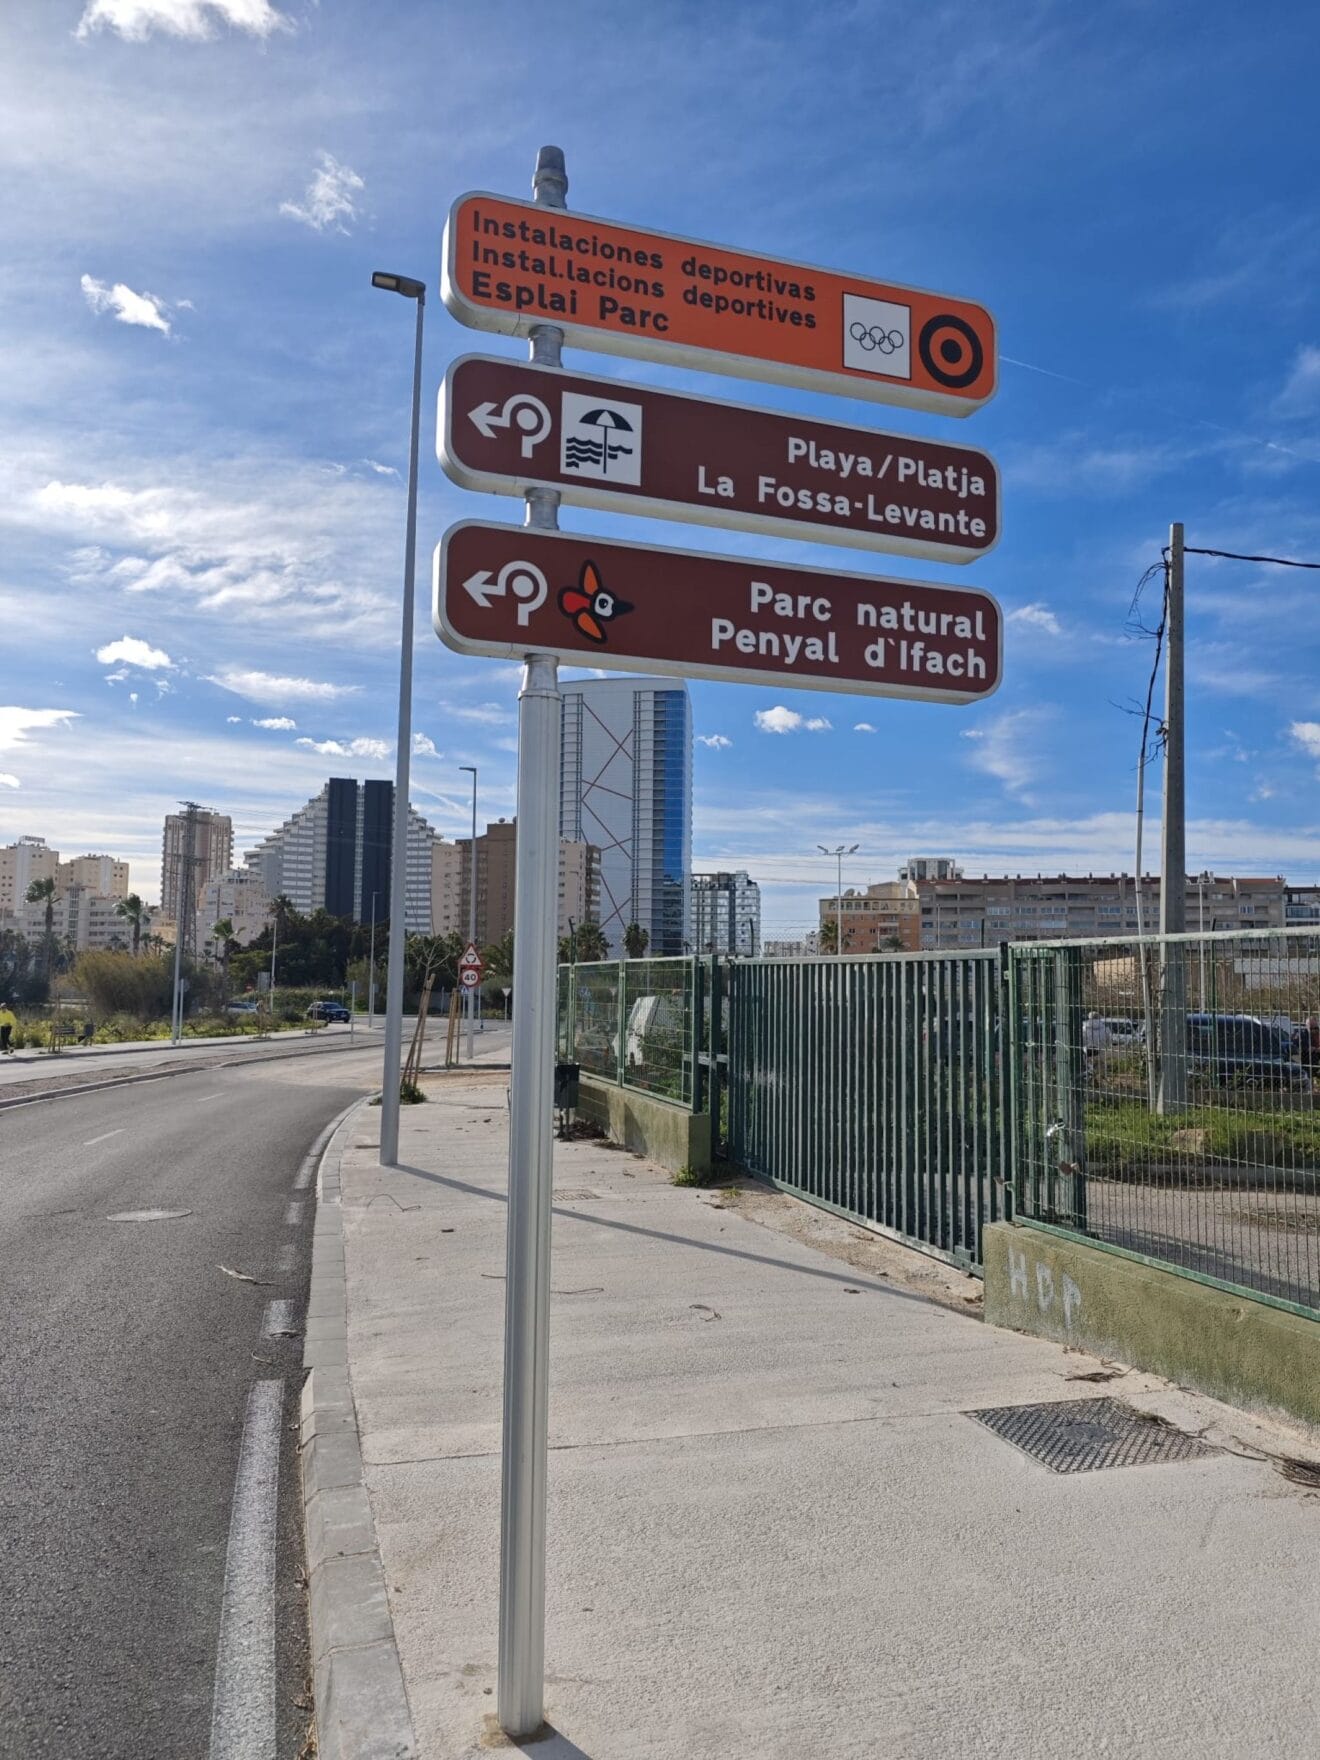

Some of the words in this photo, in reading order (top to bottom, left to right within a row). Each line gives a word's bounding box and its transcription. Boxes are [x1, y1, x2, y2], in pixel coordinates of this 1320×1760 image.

[473, 210, 663, 269] Instalaciones
[681, 256, 816, 301] deportivas
[472, 271, 577, 314] Esplai
[599, 296, 669, 332] Parc
[683, 285, 817, 329] deportives
[788, 437, 986, 498] Playa/Platja
[698, 466, 735, 498] La
[758, 476, 986, 538] Fossa-Levante
[711, 618, 839, 664] Penyal
[751, 581, 832, 621] Parc
[857, 602, 986, 640] natural
